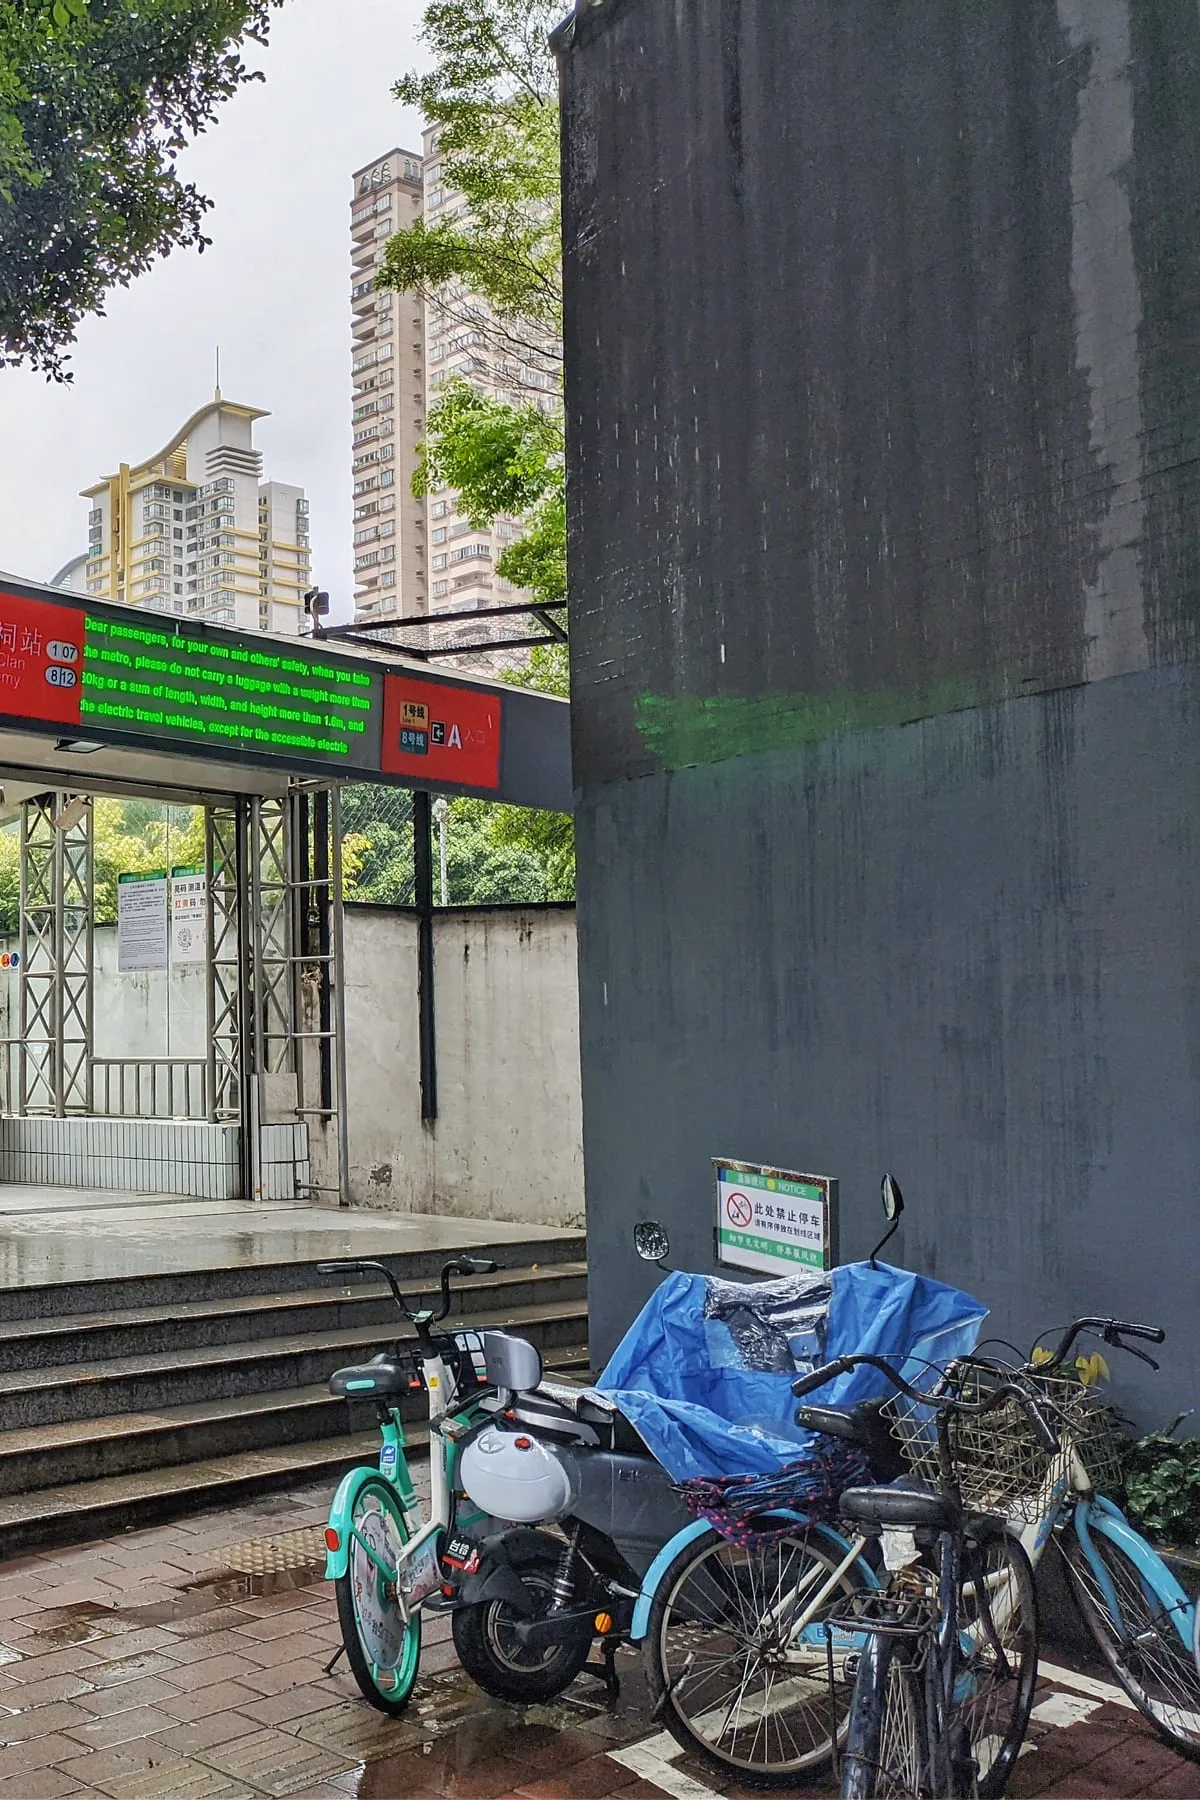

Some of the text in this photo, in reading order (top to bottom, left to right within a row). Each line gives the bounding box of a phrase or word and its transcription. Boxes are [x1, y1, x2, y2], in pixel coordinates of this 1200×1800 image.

[52, 644, 76, 660] 1 07
[84, 616, 108, 634] Dear
[110, 624, 169, 648] passengers,
[172, 635, 186, 649] for
[187, 640, 209, 654] your
[210, 645, 229, 658] own
[230, 649, 249, 662] and
[250, 652, 280, 668] others'
[281, 659, 310, 677] safety,
[311, 664, 335, 679] when
[335, 669, 351, 683] you
[50, 670, 74, 685] 8 12
[101, 649, 133, 668] metro,
[135, 655, 168, 672] please
[169, 661, 182, 675] do
[184, 665, 201, 678] not
[201, 669, 225, 686] carry
[226, 674, 233, 684] a
[235, 673, 272, 693] luggage
[272, 682, 291, 695] with
[292, 686, 299, 696] a
[300, 688, 329, 703] weight
[329, 693, 351, 706] more
[351, 695, 370, 710] than
[107, 677, 119, 689] or
[119, 680, 127, 691] a
[129, 682, 150, 695] sum
[152, 685, 164, 697] of
[165, 686, 198, 706] length,
[200, 694, 228, 711] width,
[230, 700, 248, 712] and
[249, 701, 278, 719] height
[279, 709, 301, 721] more
[302, 711, 322, 725] than
[347, 720, 365, 733] and
[402, 703, 425, 720] 1号线
[79, 698, 348, 754] the electric travel vehicles, except for the accessible electric
[401, 731, 425, 747] 8号线
[447, 723, 462, 750] A
[778, 1181, 807, 1196] NOTICE
[754, 1201, 821, 1228] 此处禁止停车
